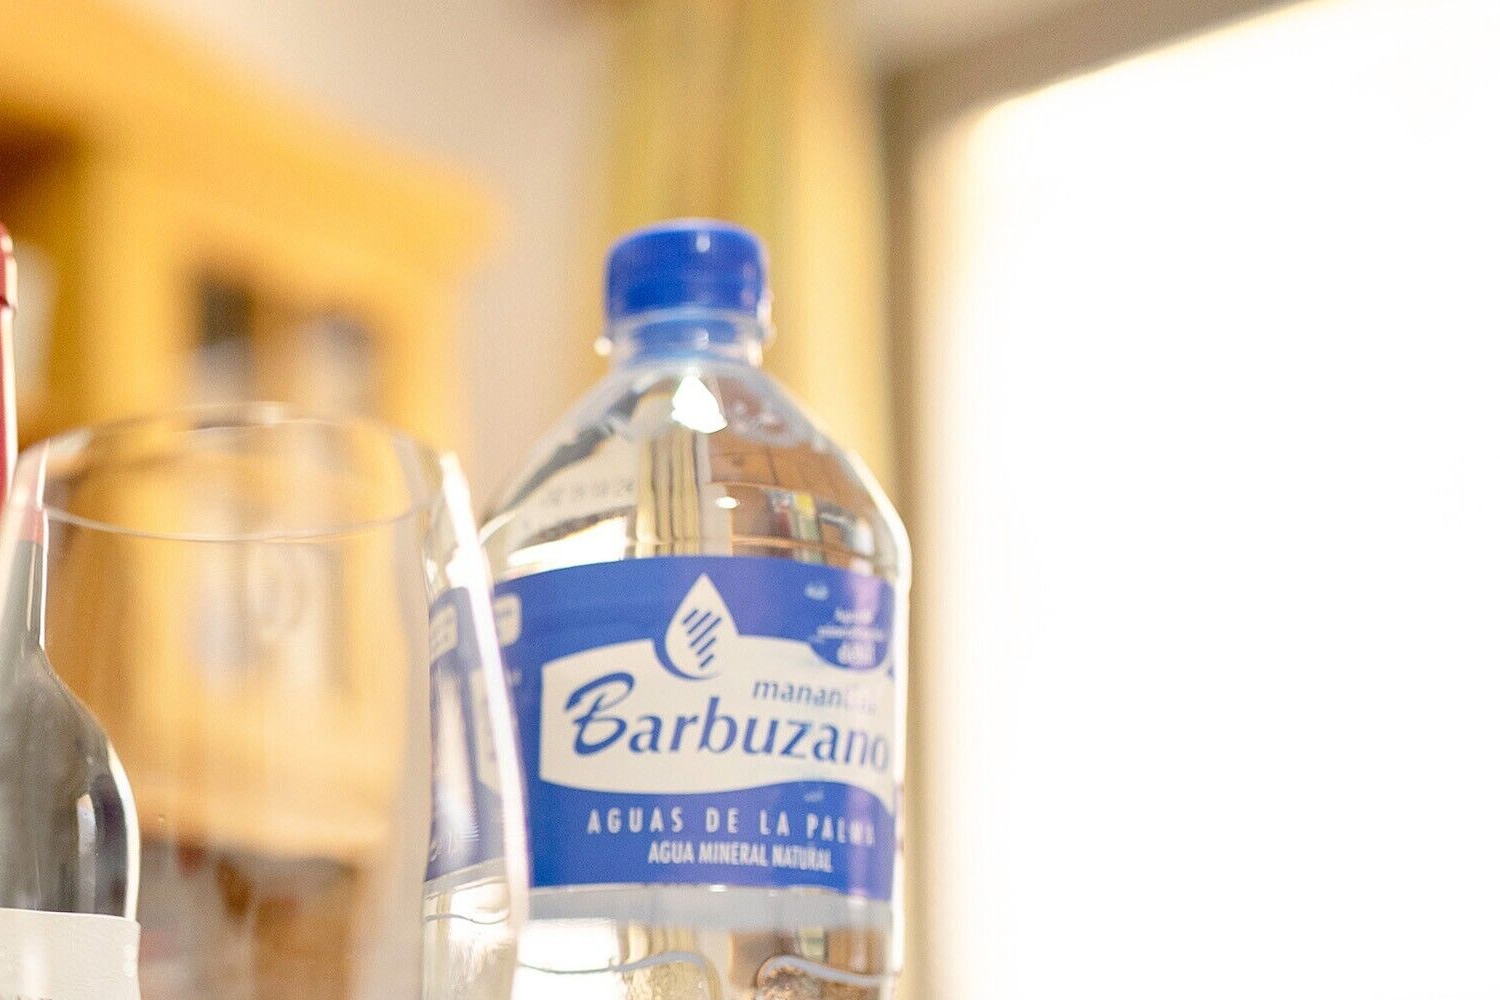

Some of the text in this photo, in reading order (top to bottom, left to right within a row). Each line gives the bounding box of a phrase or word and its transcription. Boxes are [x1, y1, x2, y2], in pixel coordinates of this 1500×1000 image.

[564, 671, 890, 773] Barbuzano
[586, 807, 684, 834] AGUAS
[705, 808, 739, 833] DE
[760, 810, 791, 837] LA
[648, 840, 833, 873] AGUA MINERAL NATURAL
